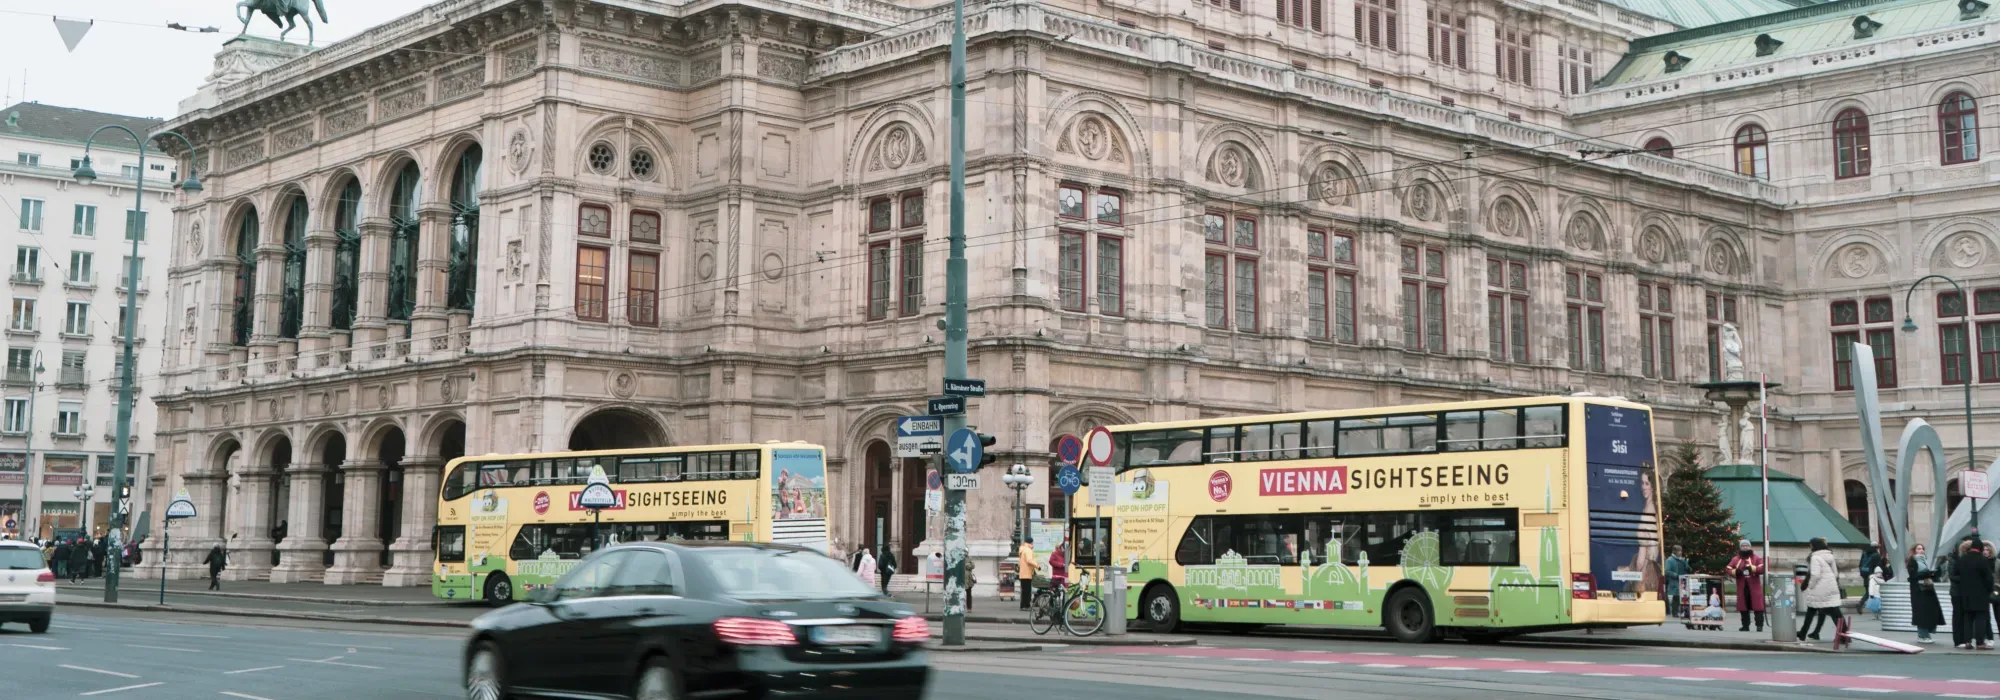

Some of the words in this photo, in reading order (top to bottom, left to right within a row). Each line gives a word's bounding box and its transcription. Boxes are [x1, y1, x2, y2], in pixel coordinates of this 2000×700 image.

[950, 383, 970, 392] Kärntner
[970, 384, 984, 392] Straße
[938, 402, 959, 412] Opernring
[912, 421, 938, 431] EINBAHN
[1612, 440, 1628, 454] Sisi
[1262, 469, 1343, 493] VIENNA
[1350, 463, 1509, 490] SIGHTSEEING
[588, 486, 609, 495] AUTOBUS
[1213, 484, 1228, 495] No.1
[628, 489, 727, 507] SIGHTSEEING
[1420, 494, 1457, 505] simply
[1461, 493, 1479, 502] the
[1484, 492, 1509, 501] best
[1130, 504, 1140, 512] ON
[1140, 504, 1153, 512] HOP
[1153, 503, 1166, 511] OFF
